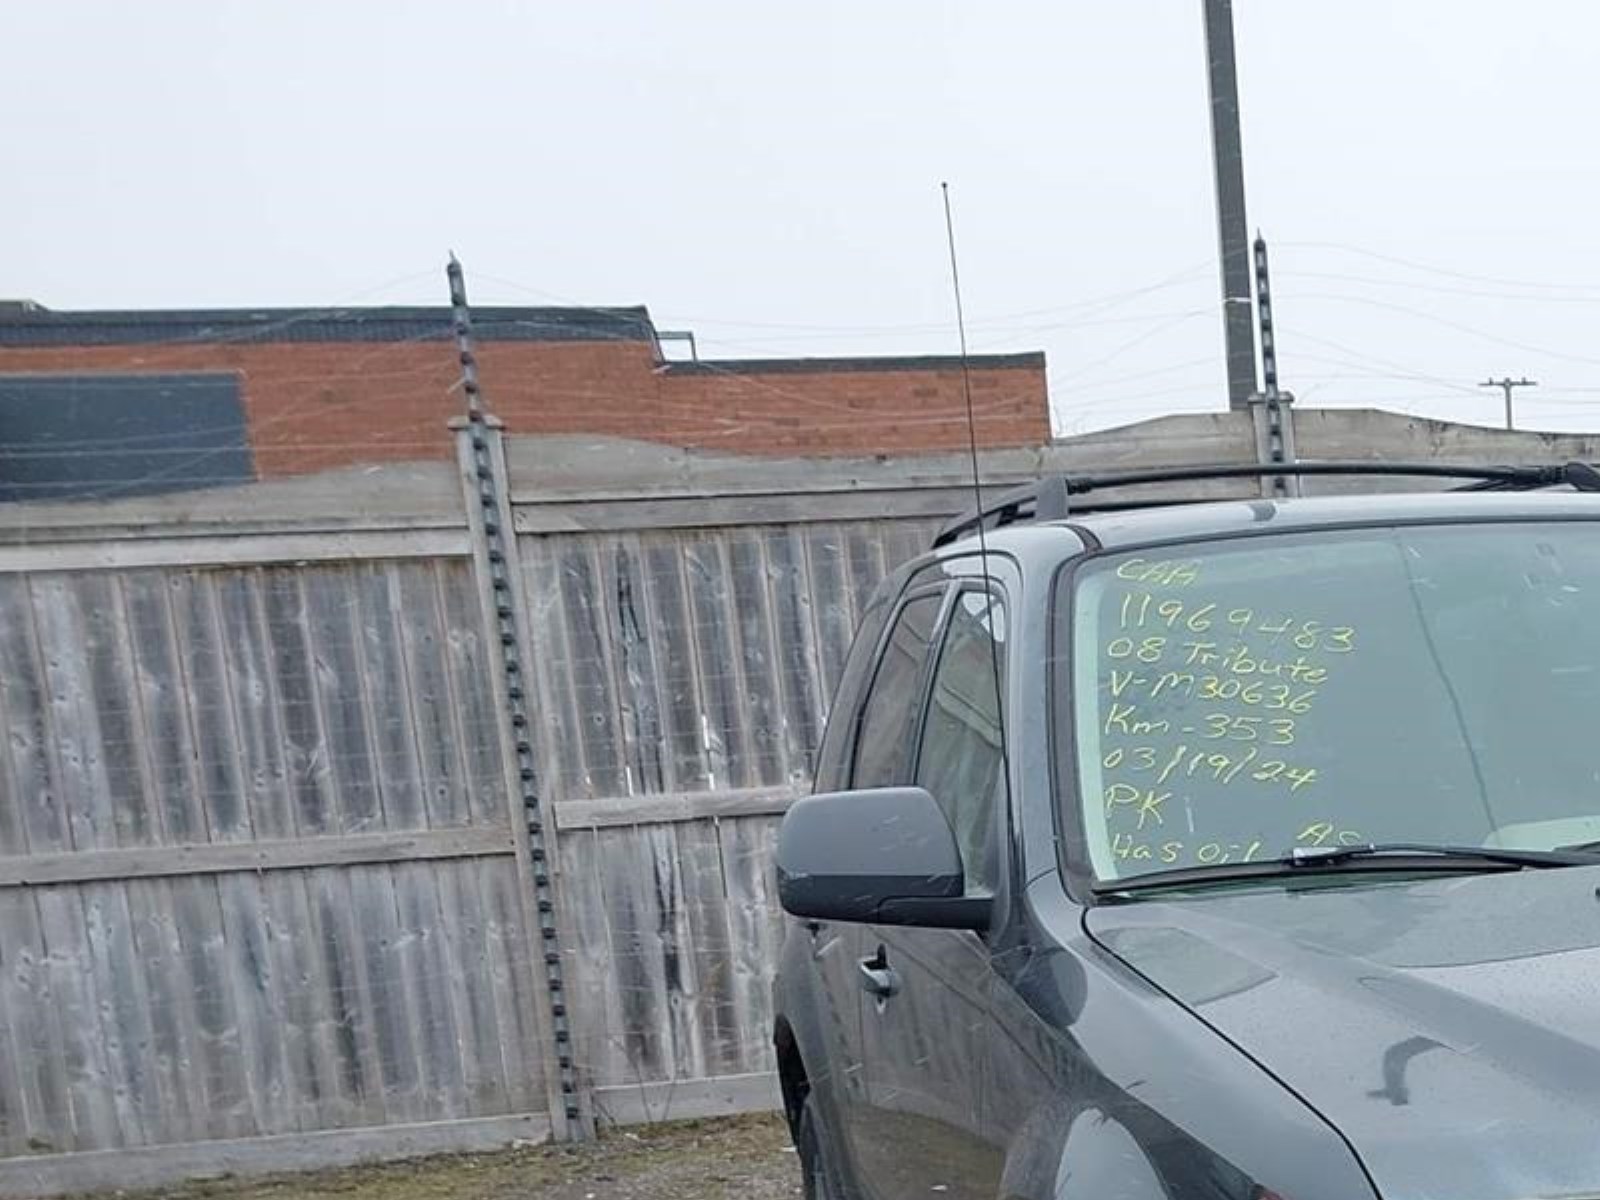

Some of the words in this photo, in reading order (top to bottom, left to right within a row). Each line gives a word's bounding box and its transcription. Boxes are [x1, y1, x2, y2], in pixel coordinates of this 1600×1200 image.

[1120, 593, 1356, 652] 11969483
[1107, 636, 1168, 663] 08
[1183, 640, 1329, 685] Tribute
[1102, 745, 1317, 793] 03/19/24
[1104, 783, 1173, 829] PK
